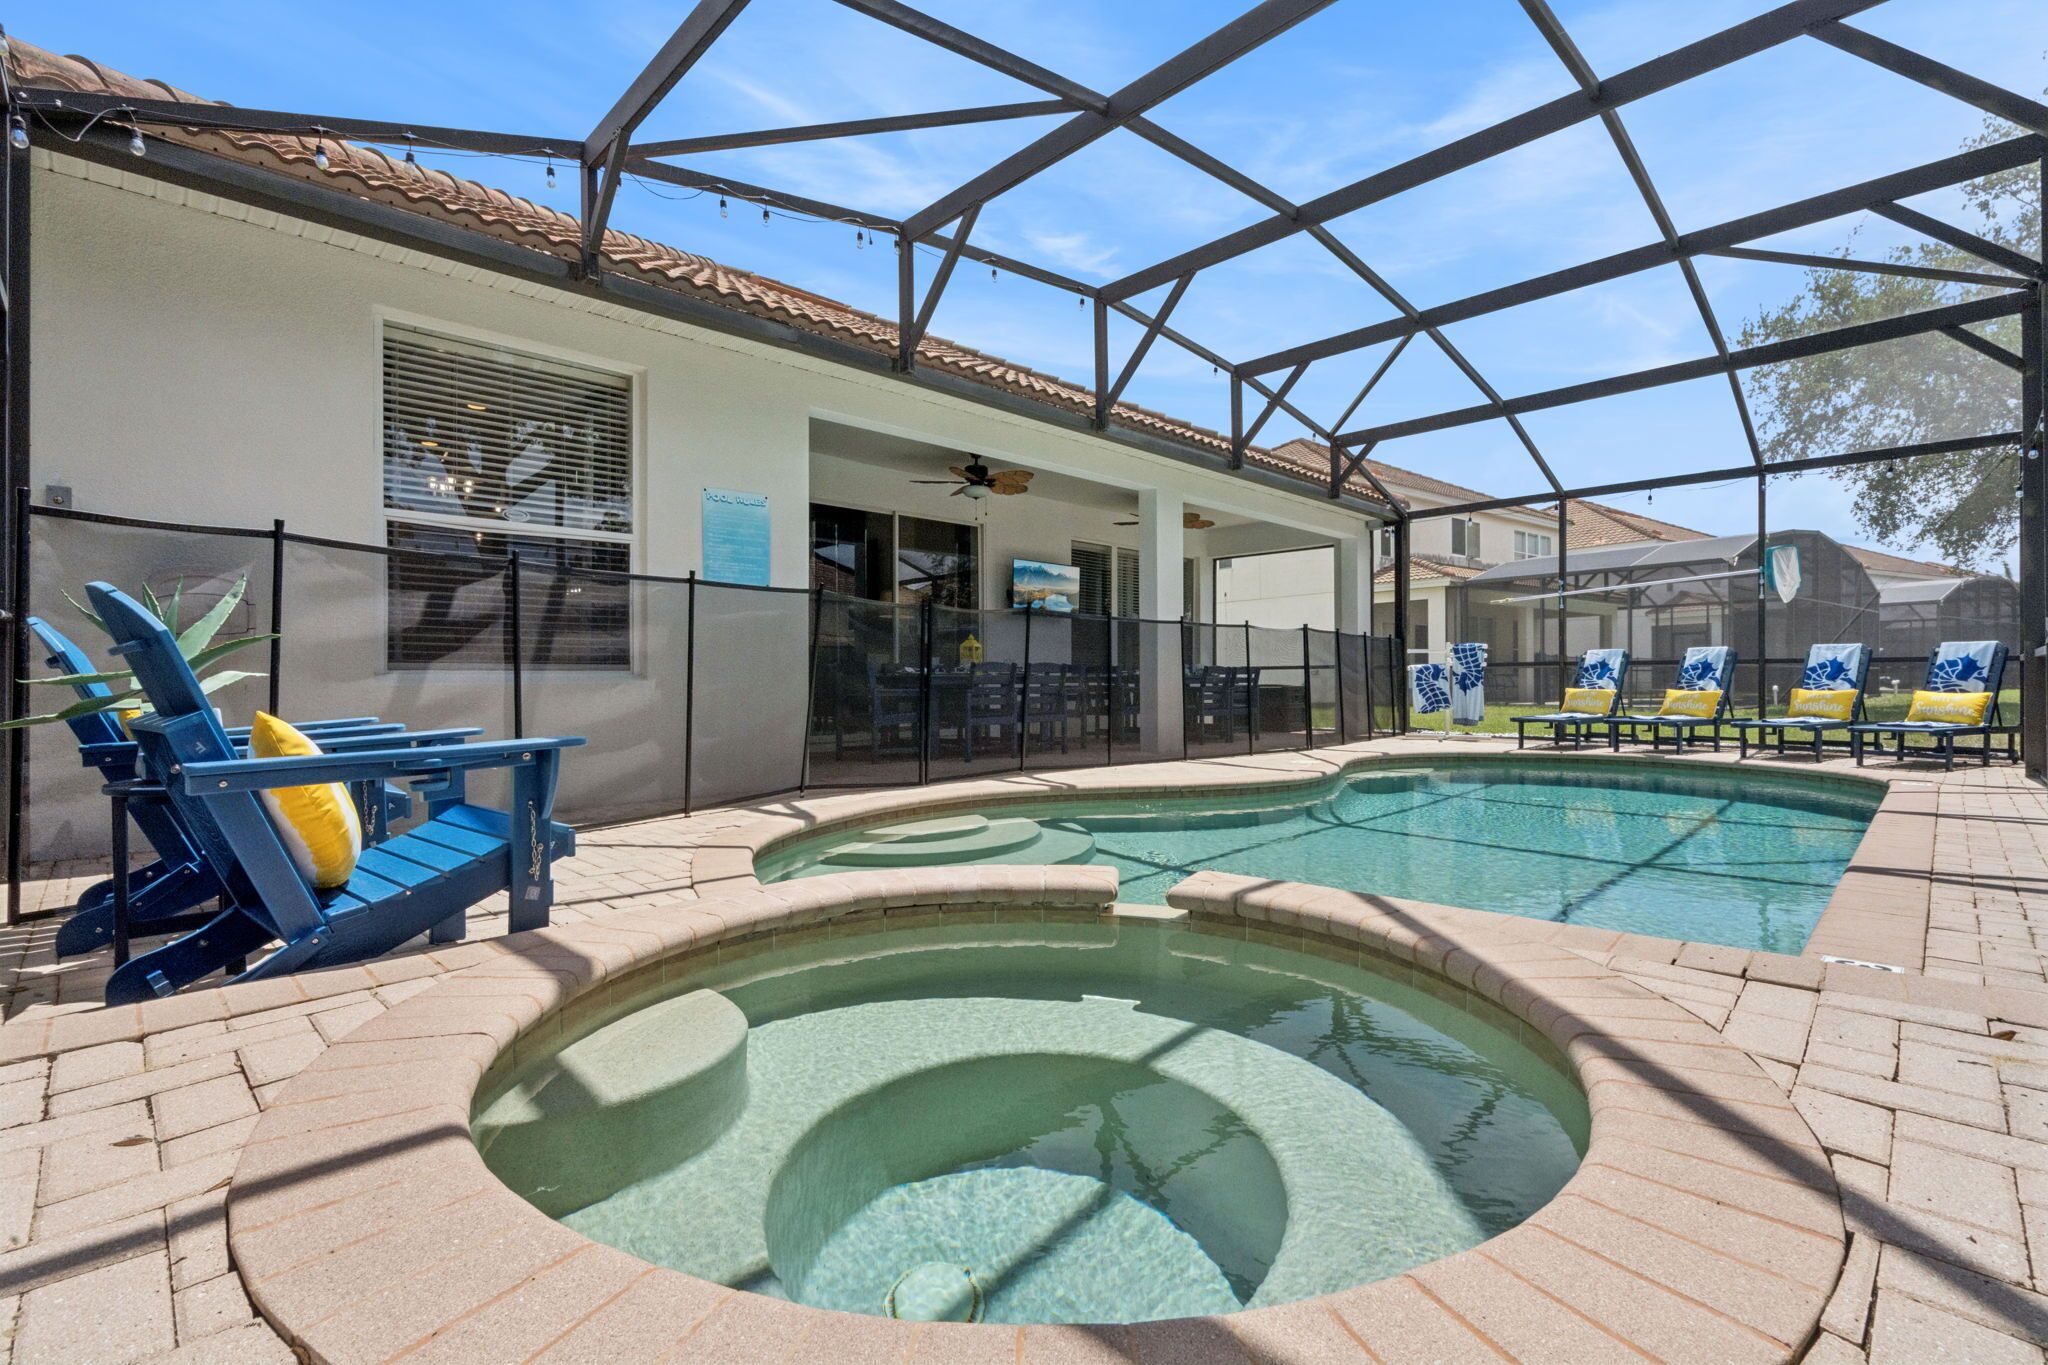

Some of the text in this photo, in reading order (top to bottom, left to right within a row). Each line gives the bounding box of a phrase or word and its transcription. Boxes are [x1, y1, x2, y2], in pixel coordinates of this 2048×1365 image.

[705, 492, 767, 507] POOL RULES
[1916, 701, 1977, 716] Sunshine
